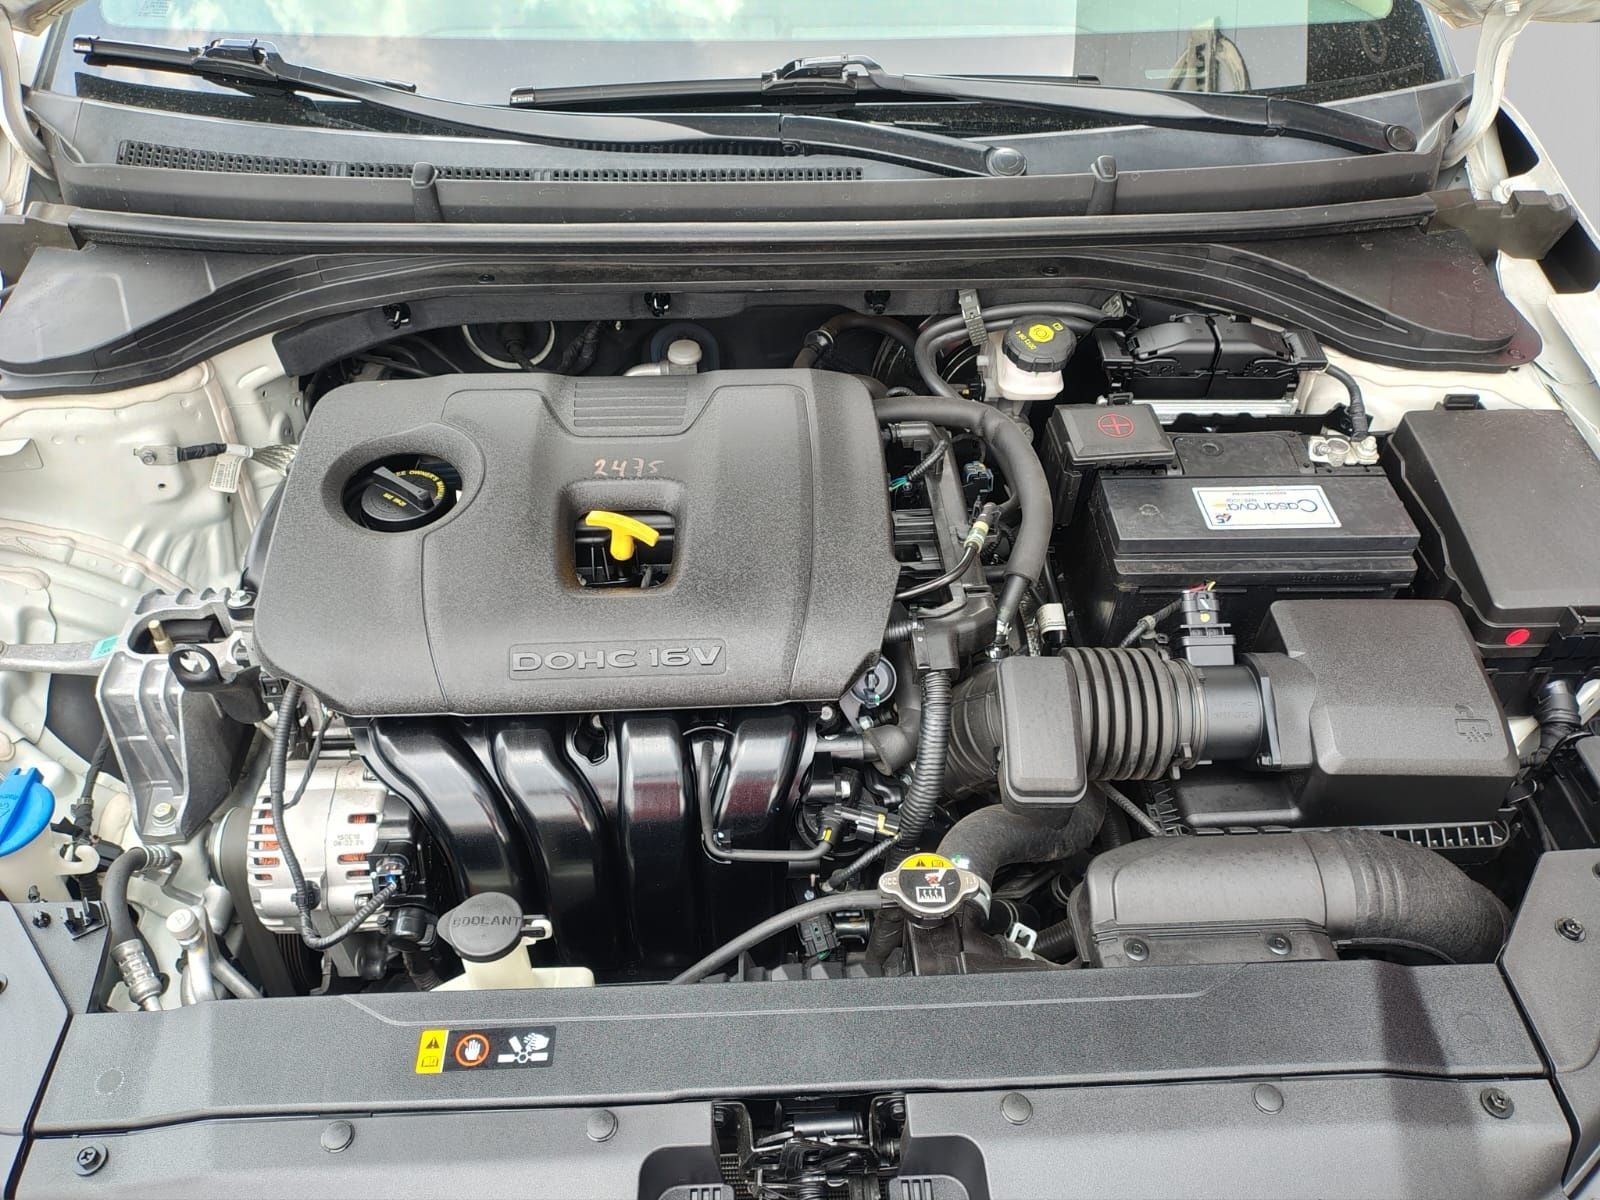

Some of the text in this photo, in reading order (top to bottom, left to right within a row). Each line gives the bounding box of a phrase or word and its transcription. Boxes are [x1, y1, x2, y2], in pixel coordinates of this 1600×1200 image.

[594, 457, 665, 477] 2475
[1227, 499, 1318, 513] Casanova
[511, 645, 723, 672] DOHC 16V
[452, 915, 520, 929] COOLANT
